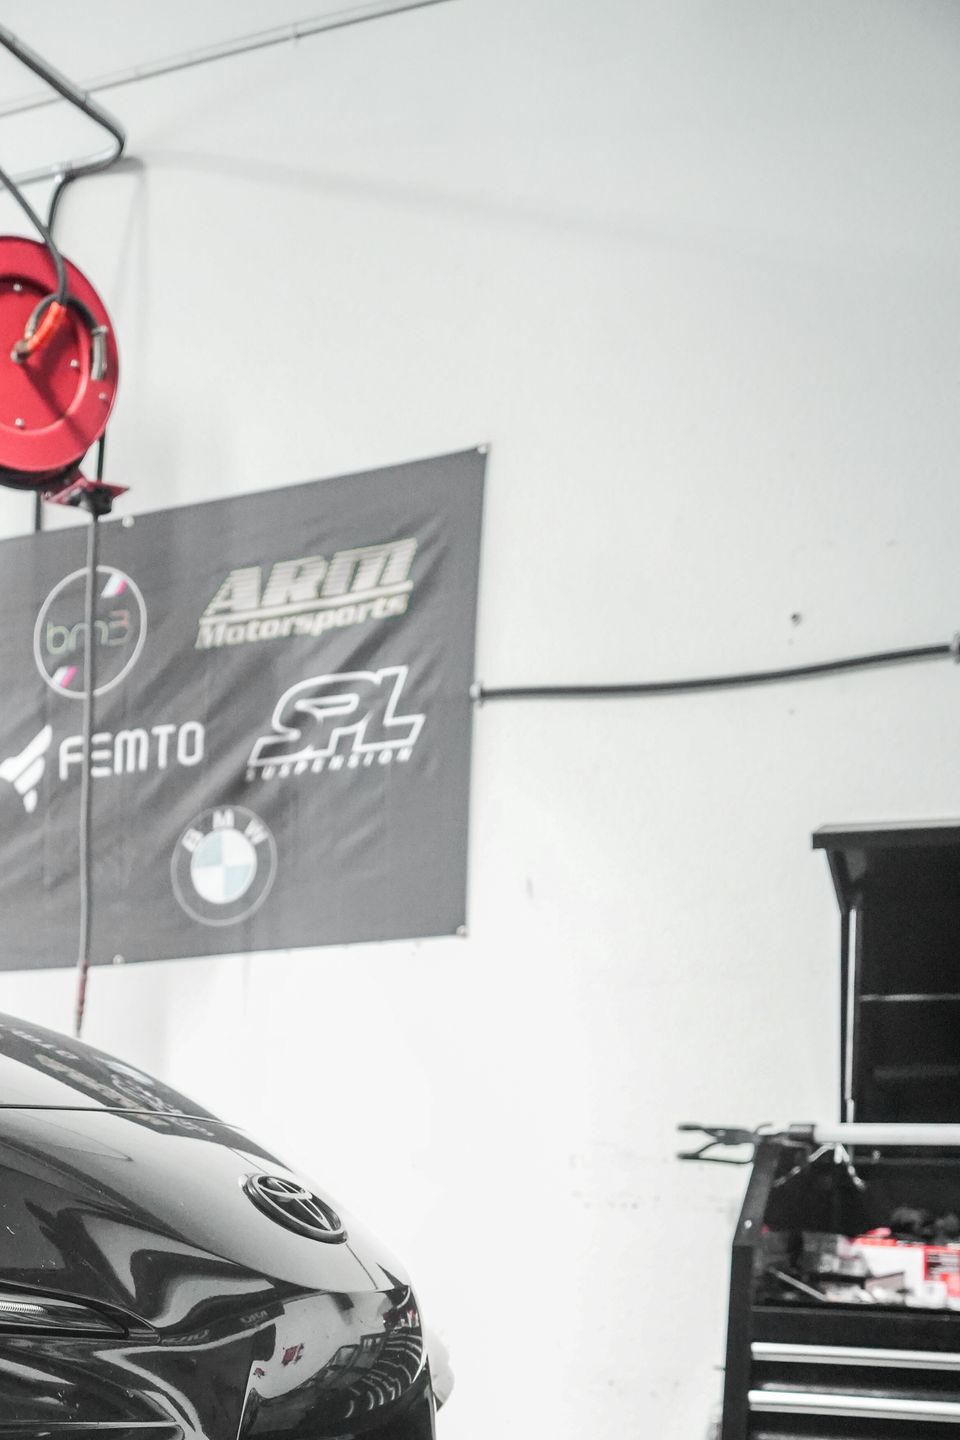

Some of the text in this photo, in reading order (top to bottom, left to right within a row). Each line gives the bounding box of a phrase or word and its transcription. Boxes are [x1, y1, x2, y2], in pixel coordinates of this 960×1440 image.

[203, 537, 418, 618] ARM
[195, 596, 410, 649] Motorsports
[59, 720, 206, 781] FEMTO
[182, 807, 270, 853] BMW
